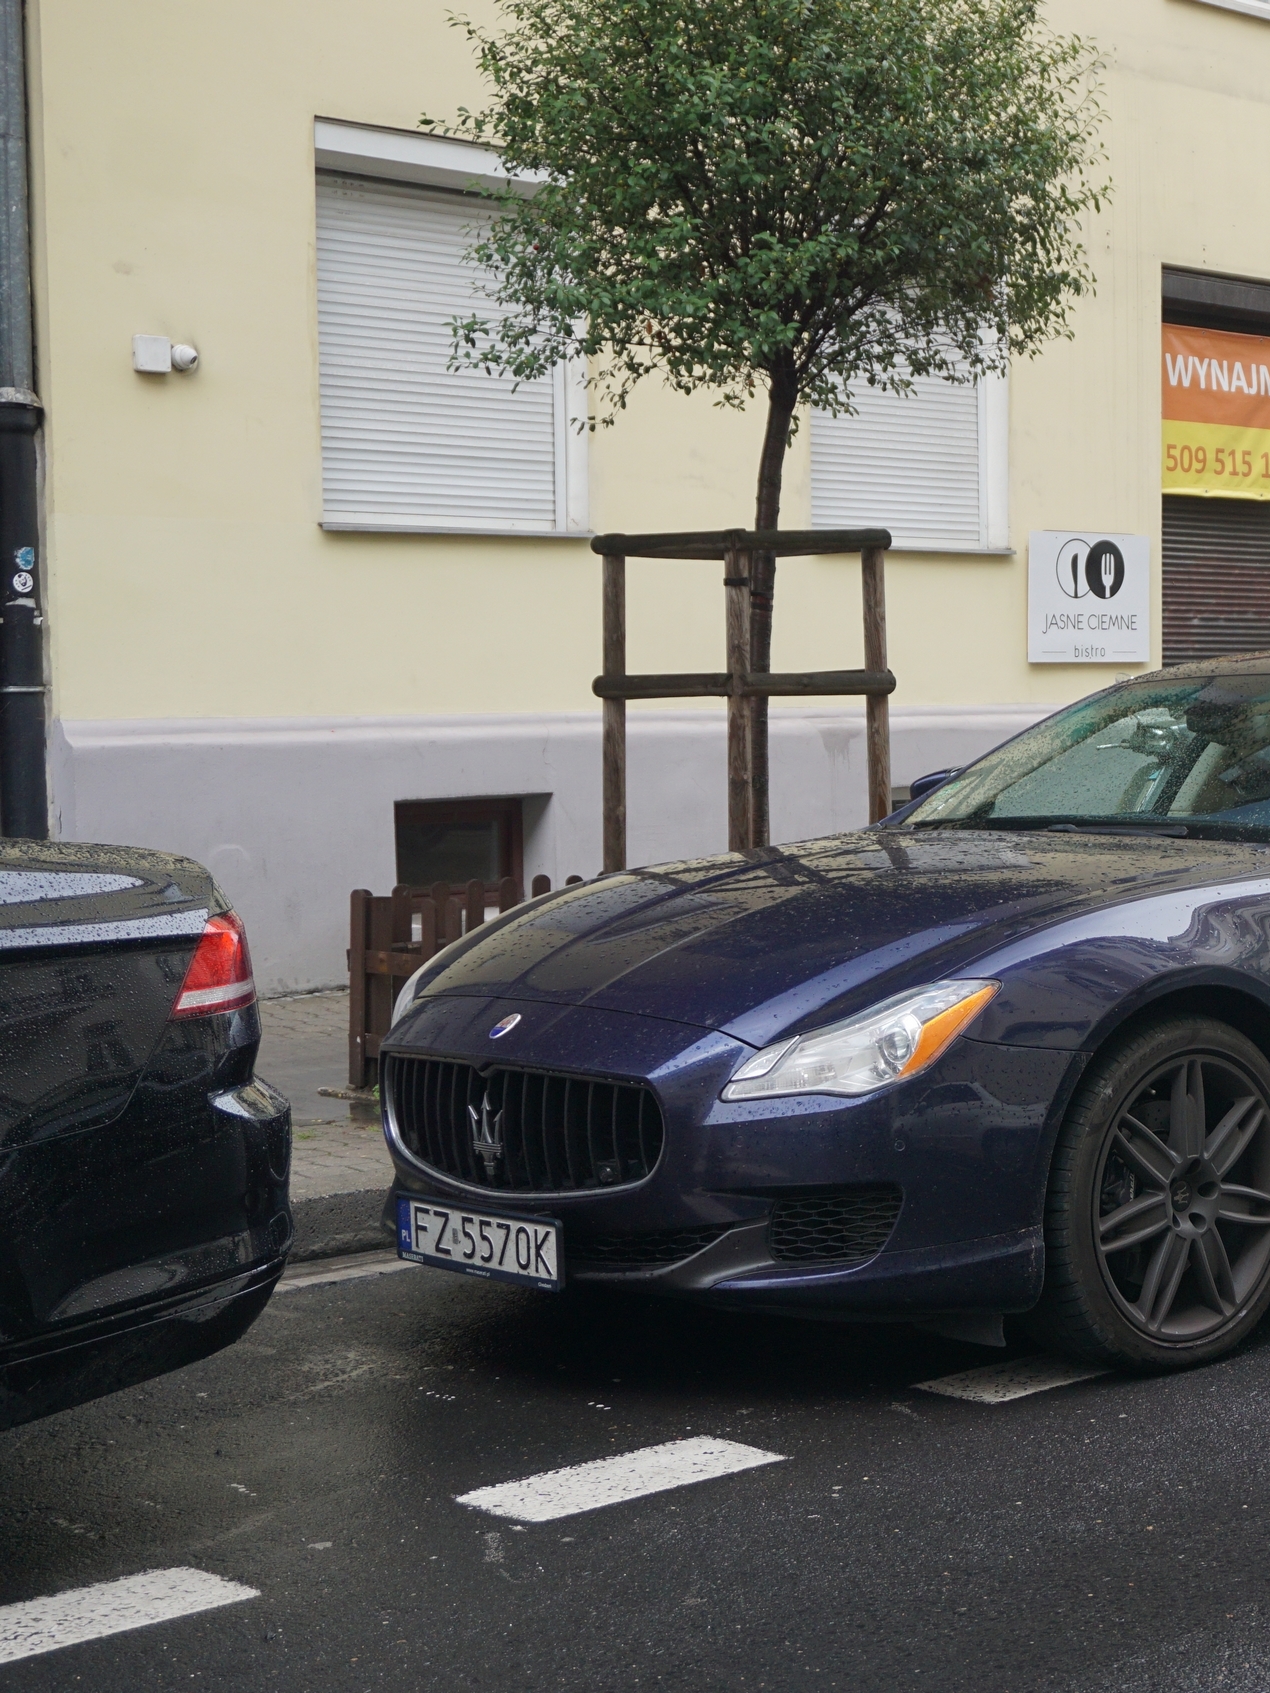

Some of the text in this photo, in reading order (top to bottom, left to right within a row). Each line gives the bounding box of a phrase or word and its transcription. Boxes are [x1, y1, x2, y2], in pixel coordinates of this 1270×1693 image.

[1166, 444, 1207, 473] 509
[1214, 448, 1252, 478] 515
[1042, 613, 1137, 634] JASNE CIEMNE
[1074, 644, 1106, 659] bistro
[401, 1230, 410, 1242] PL
[414, 1204, 553, 1276] FZ 5570K
